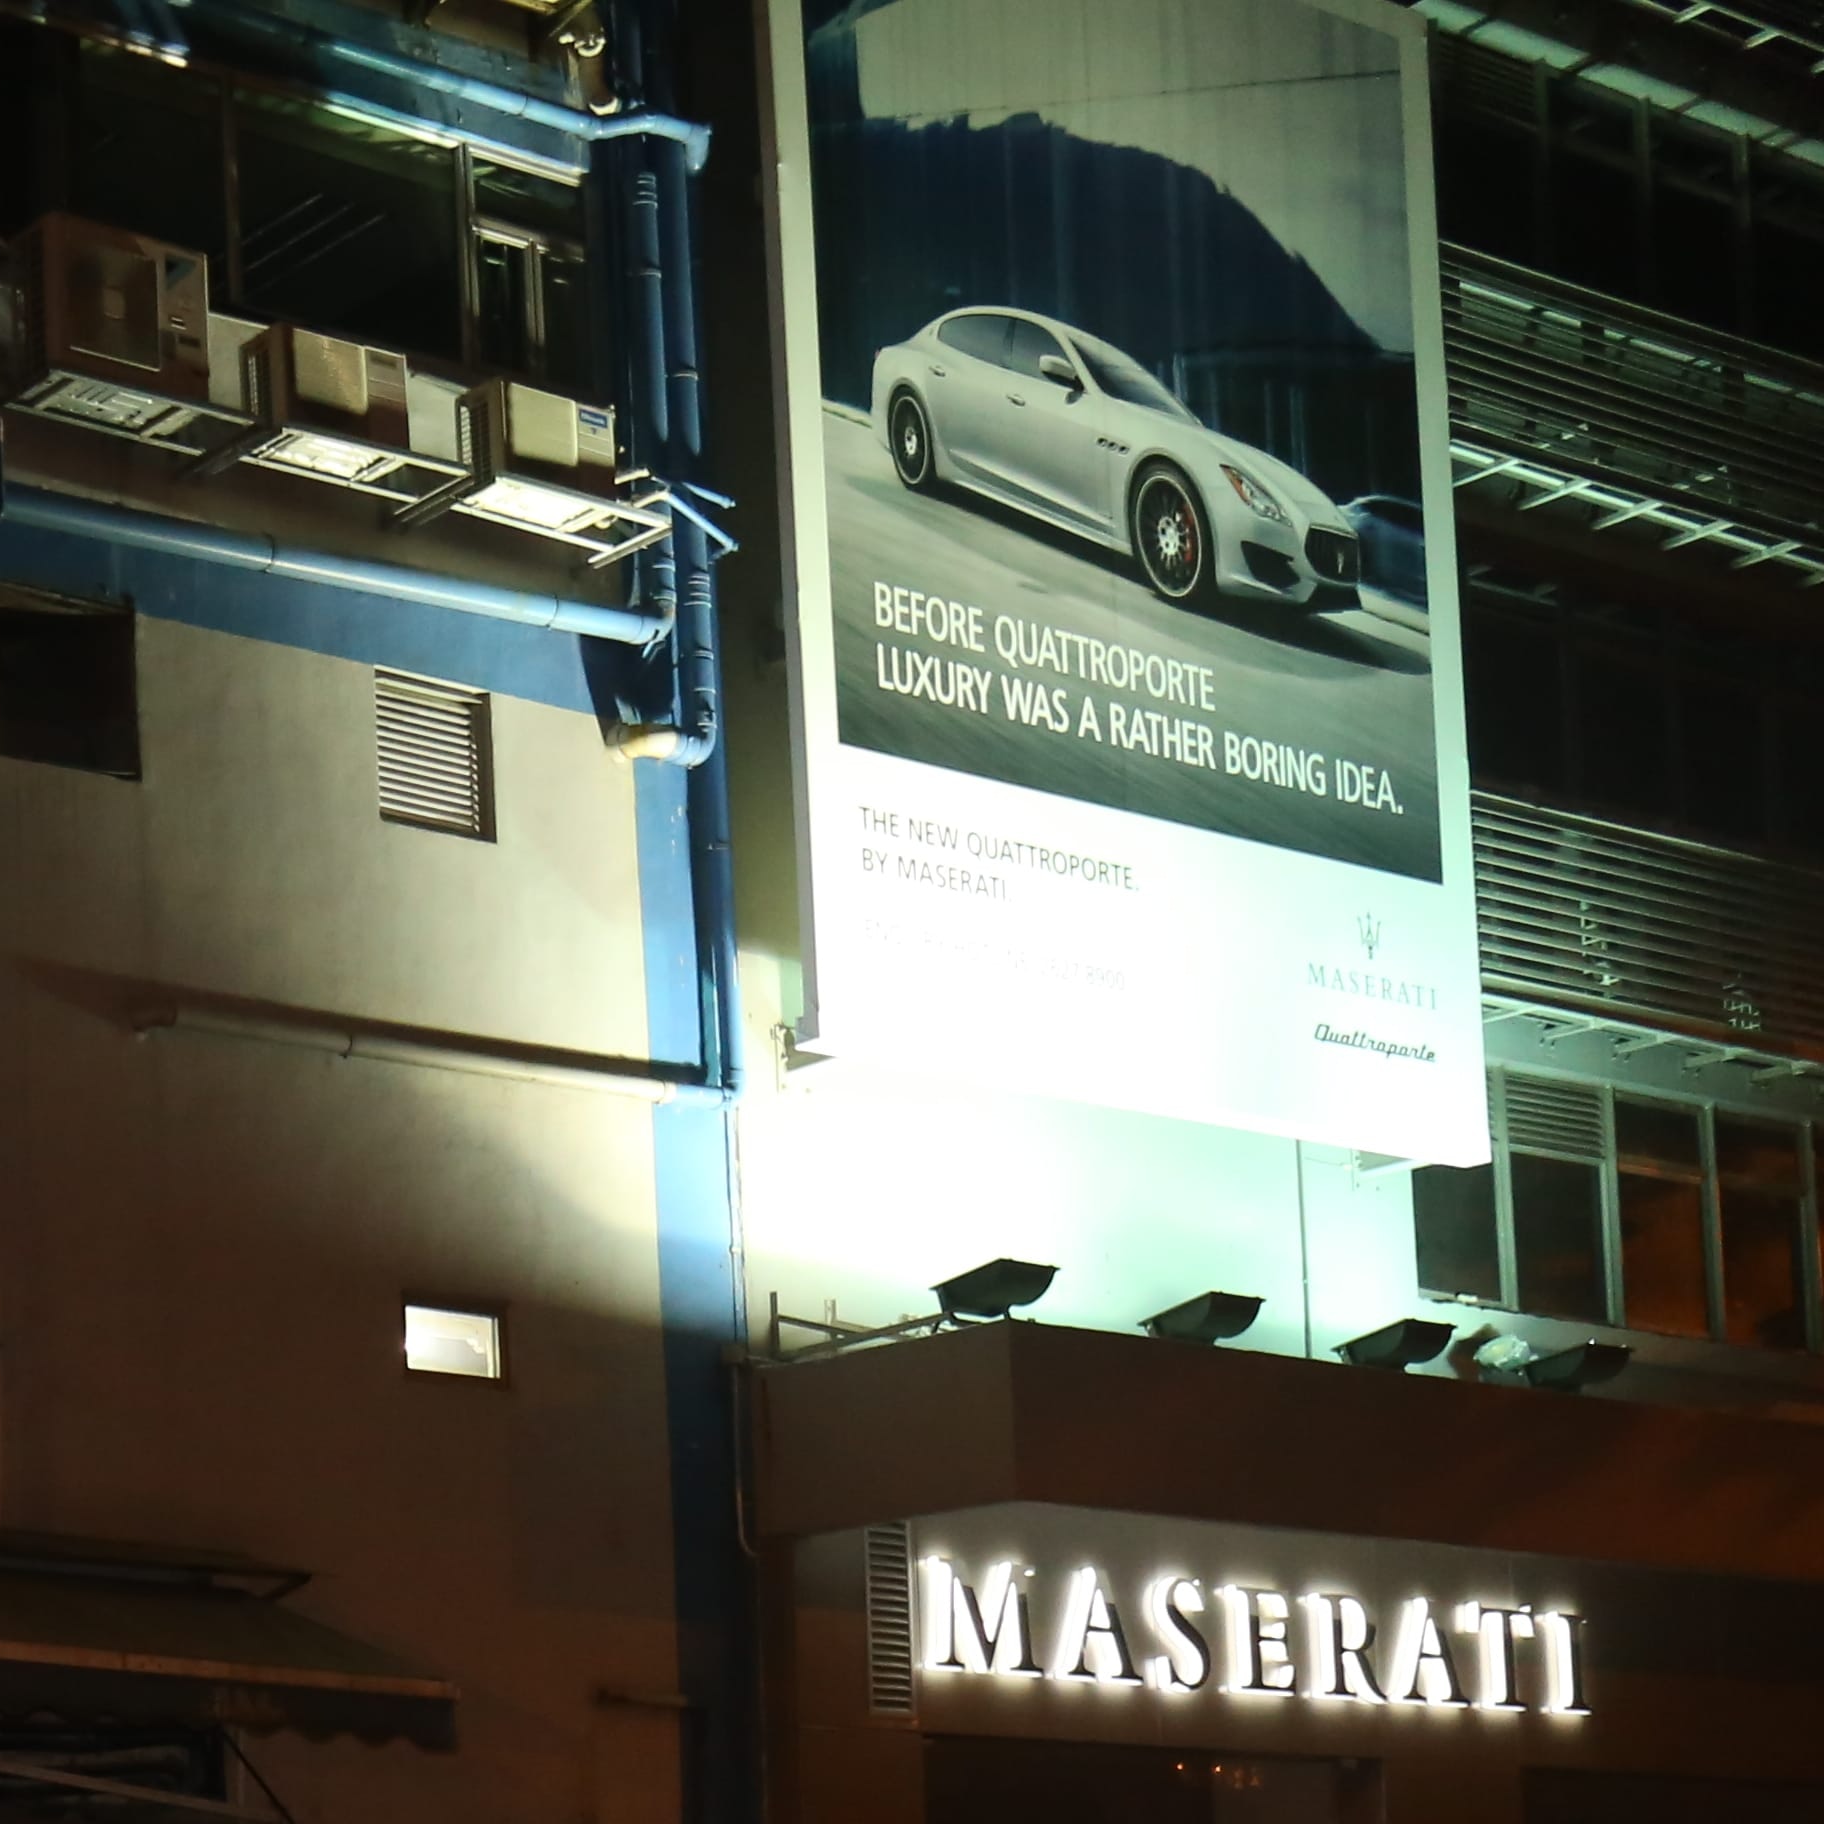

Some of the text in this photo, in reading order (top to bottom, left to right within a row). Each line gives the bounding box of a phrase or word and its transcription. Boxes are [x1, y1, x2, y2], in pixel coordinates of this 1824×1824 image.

[874, 581, 1216, 711] BEFORE QUATTROPORTE
[876, 643, 1404, 815] LUXURY WAS A RATHER BORING IDEA.
[858, 805, 1140, 892] THE NEW QUATTROPORTE.
[862, 847, 888, 875] BY
[1308, 962, 1438, 1010] MASERATI
[1314, 1023, 1436, 1062] Quattroporte
[920, 1555, 1592, 1717] MASERATI
